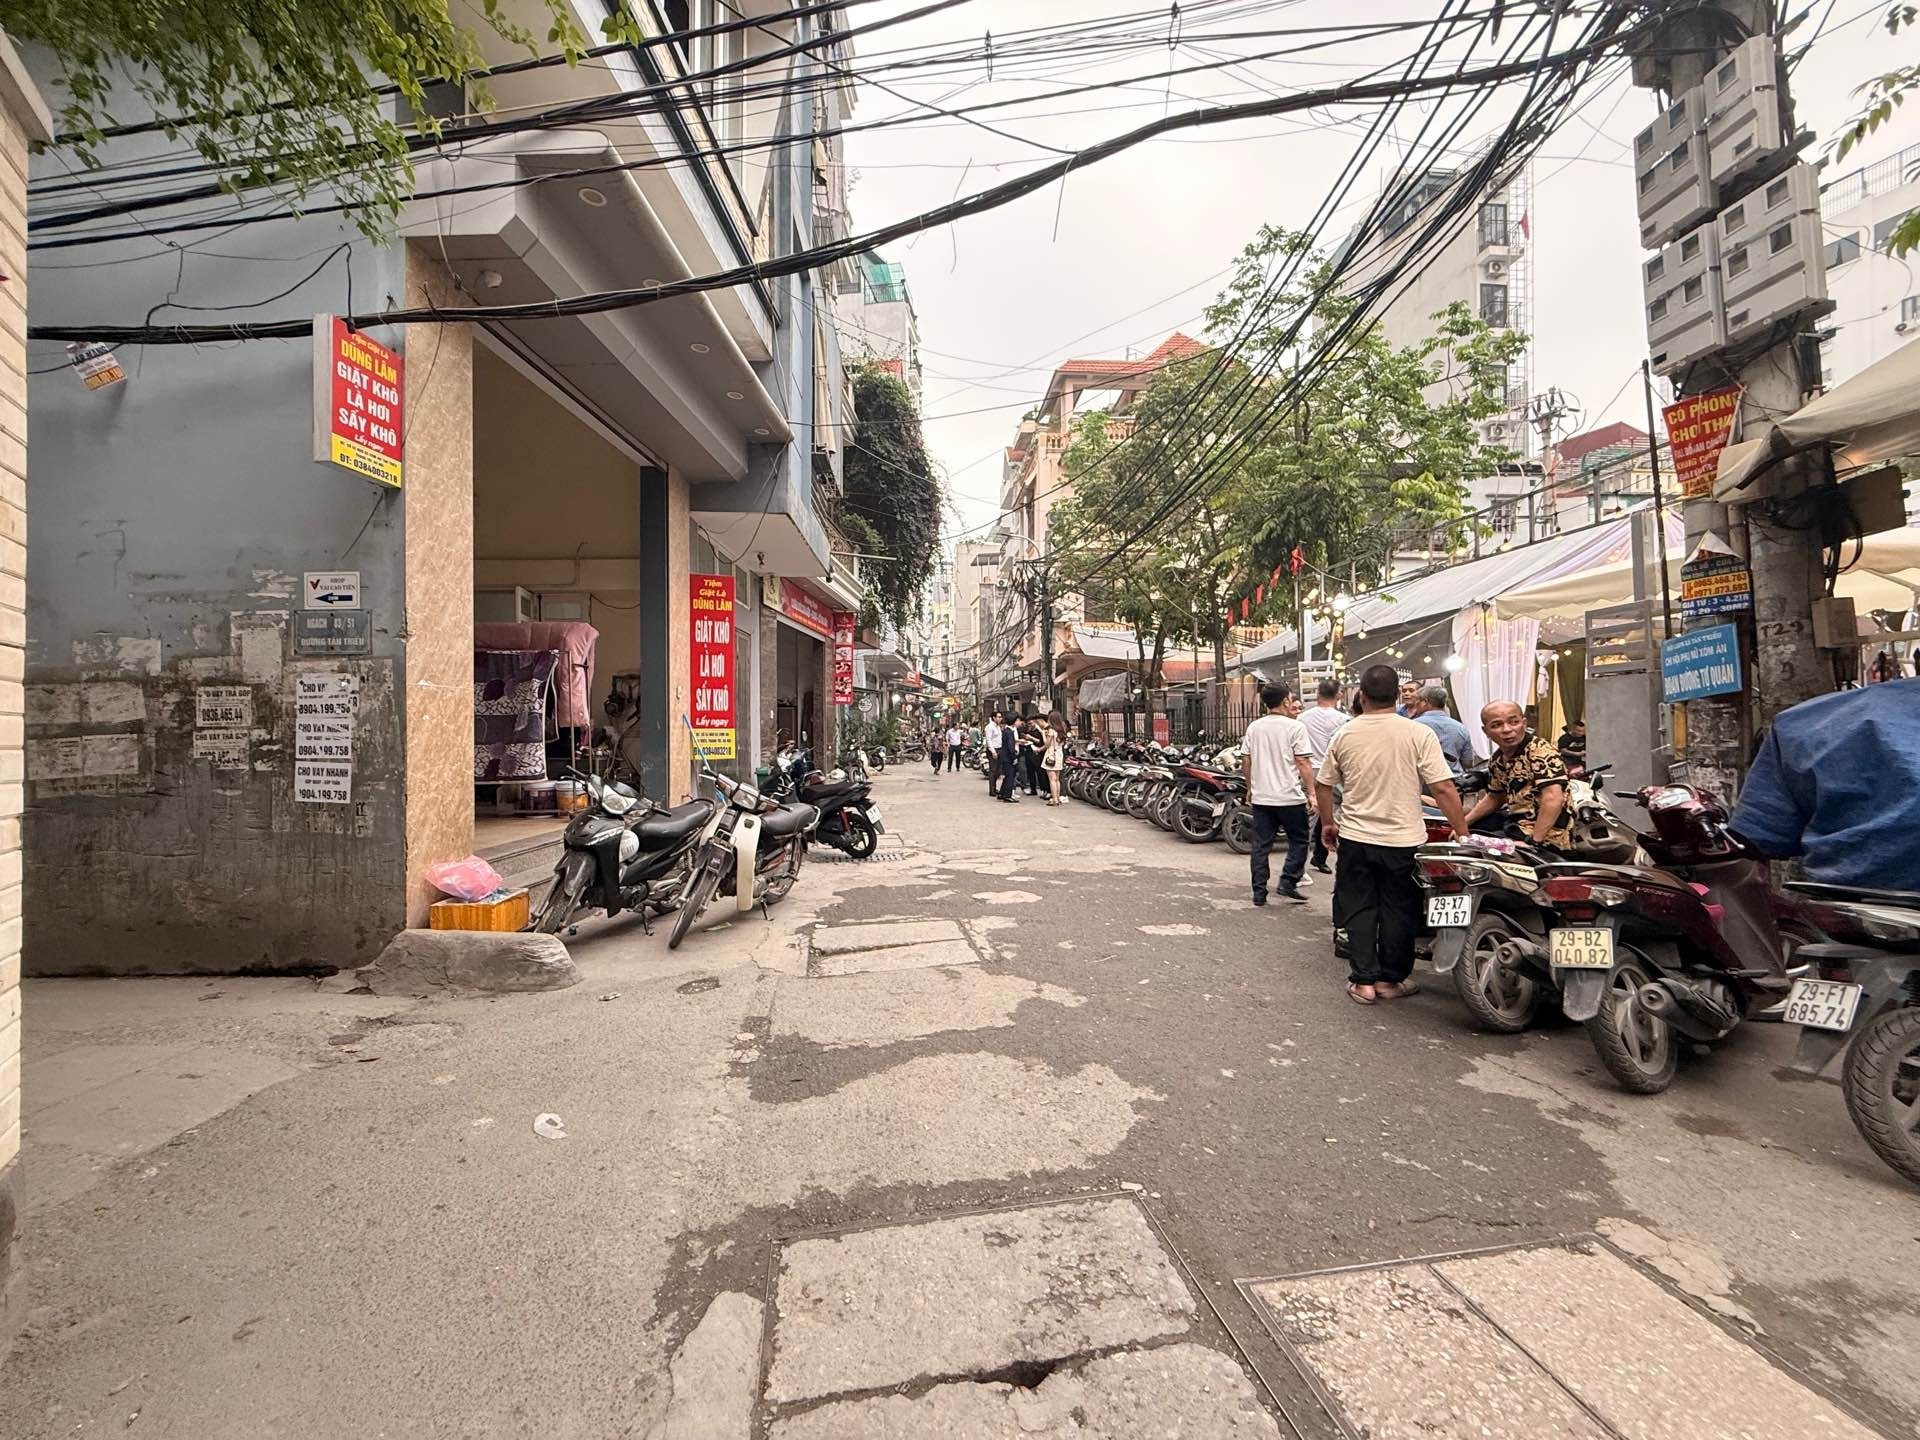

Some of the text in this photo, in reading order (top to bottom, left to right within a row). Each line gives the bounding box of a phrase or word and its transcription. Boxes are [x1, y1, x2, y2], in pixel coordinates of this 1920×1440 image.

[374, 358, 398, 385] LÂM
[337, 361, 399, 406] GIẶT KHÔ
[346, 388, 391, 423] LÀ HƠI
[1667, 406, 1687, 425] CÓ
[338, 407, 397, 447] SẤY KHÔ
[1671, 424, 1699, 443] CHO
[716, 599, 733, 612] LÂM
[695, 615, 730, 649] GIẶT KHÔ
[700, 649, 725, 678] LÀ HƠI
[1710, 657, 1735, 689] QUẢN
[302, 683, 316, 693] CHO
[696, 680, 729, 712] SẤY KHÔ
[696, 714, 710, 726] Lấy
[297, 766, 349, 777] CHO VAY NHANH
[1434, 897, 1464, 911] 29-X7
[1429, 910, 1468, 925] 471.67
[1559, 931, 1602, 947] 29-B2
[1554, 948, 1609, 965] 040.82
[1798, 983, 1848, 1006] 29-F1
[1788, 1002, 1846, 1027] 685.74
